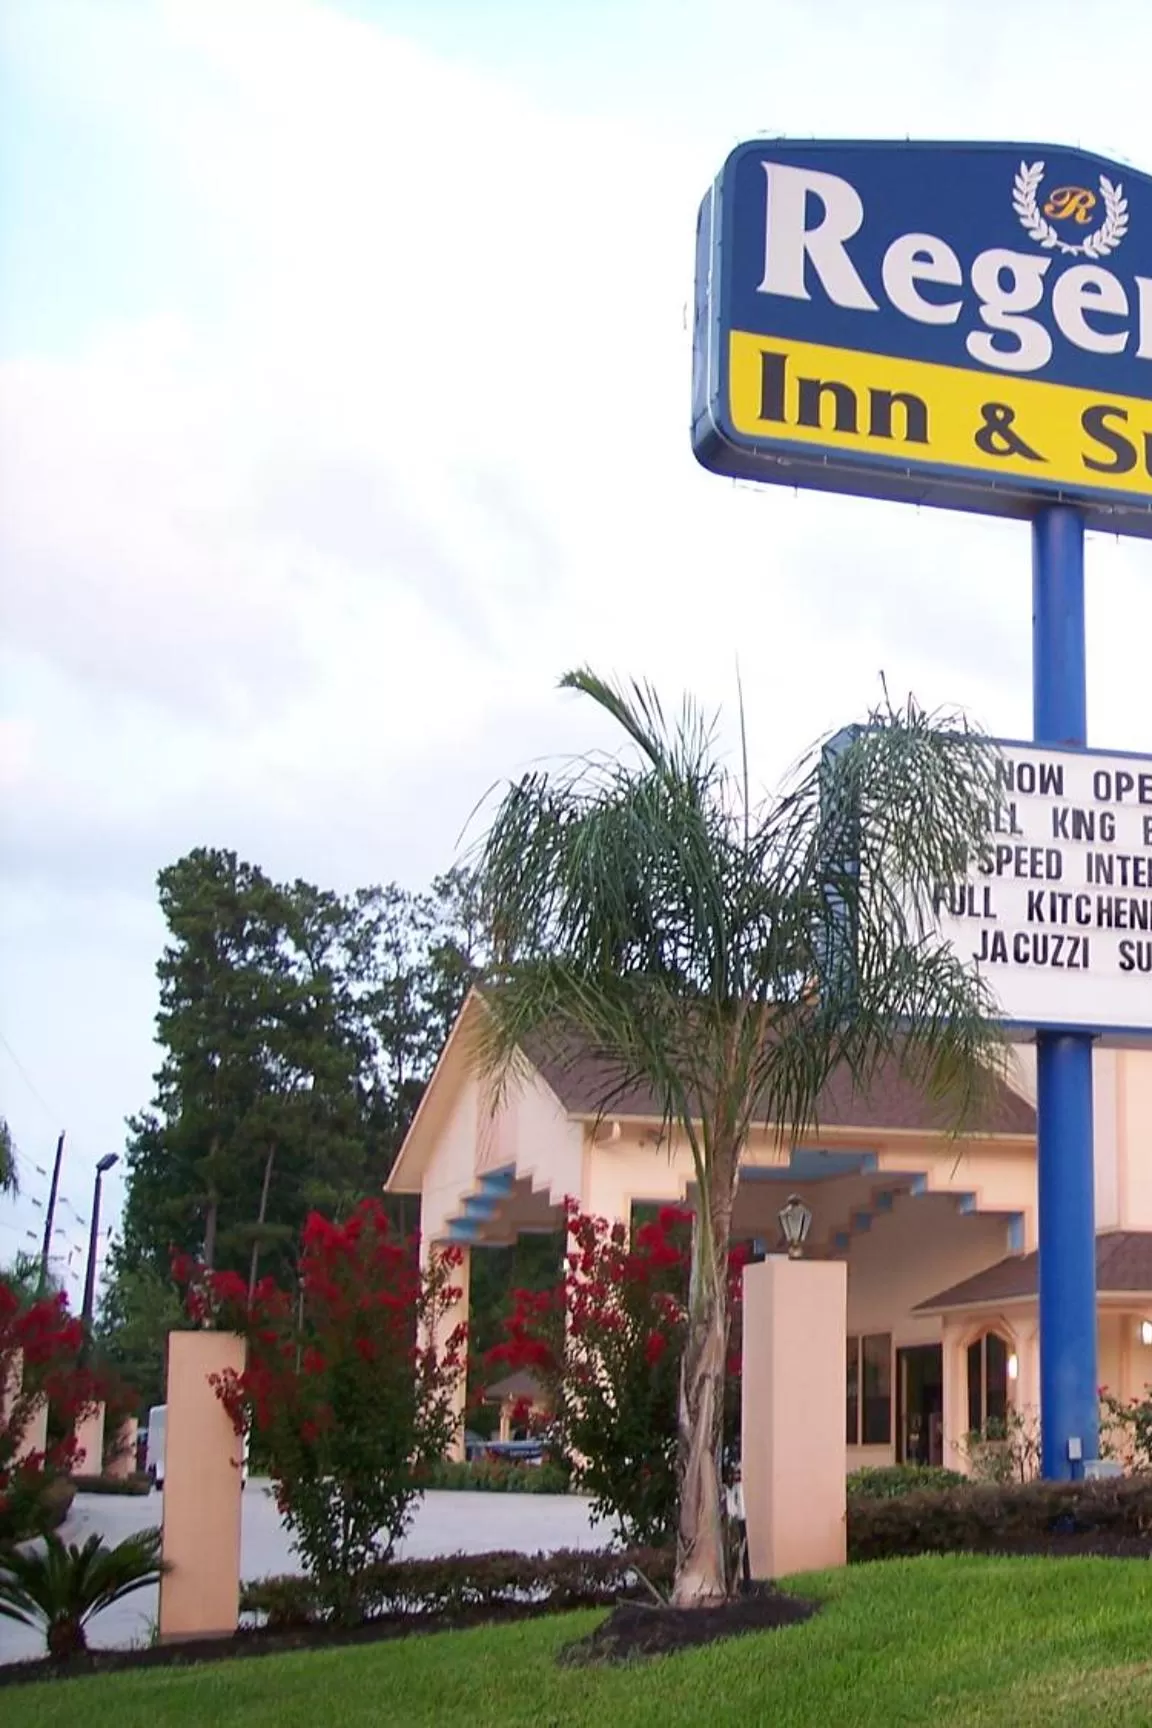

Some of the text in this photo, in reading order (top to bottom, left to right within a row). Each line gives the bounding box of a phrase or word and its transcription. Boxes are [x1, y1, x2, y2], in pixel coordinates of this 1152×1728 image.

[1044, 185, 1095, 225] R
[757, 350, 930, 444] Inn
[973, 402, 1048, 461] &
[995, 758, 1063, 796] NOW
[978, 842, 1063, 880] SPEED
[933, 882, 997, 918] FULL
[972, 929, 1090, 969] JACUZZI
